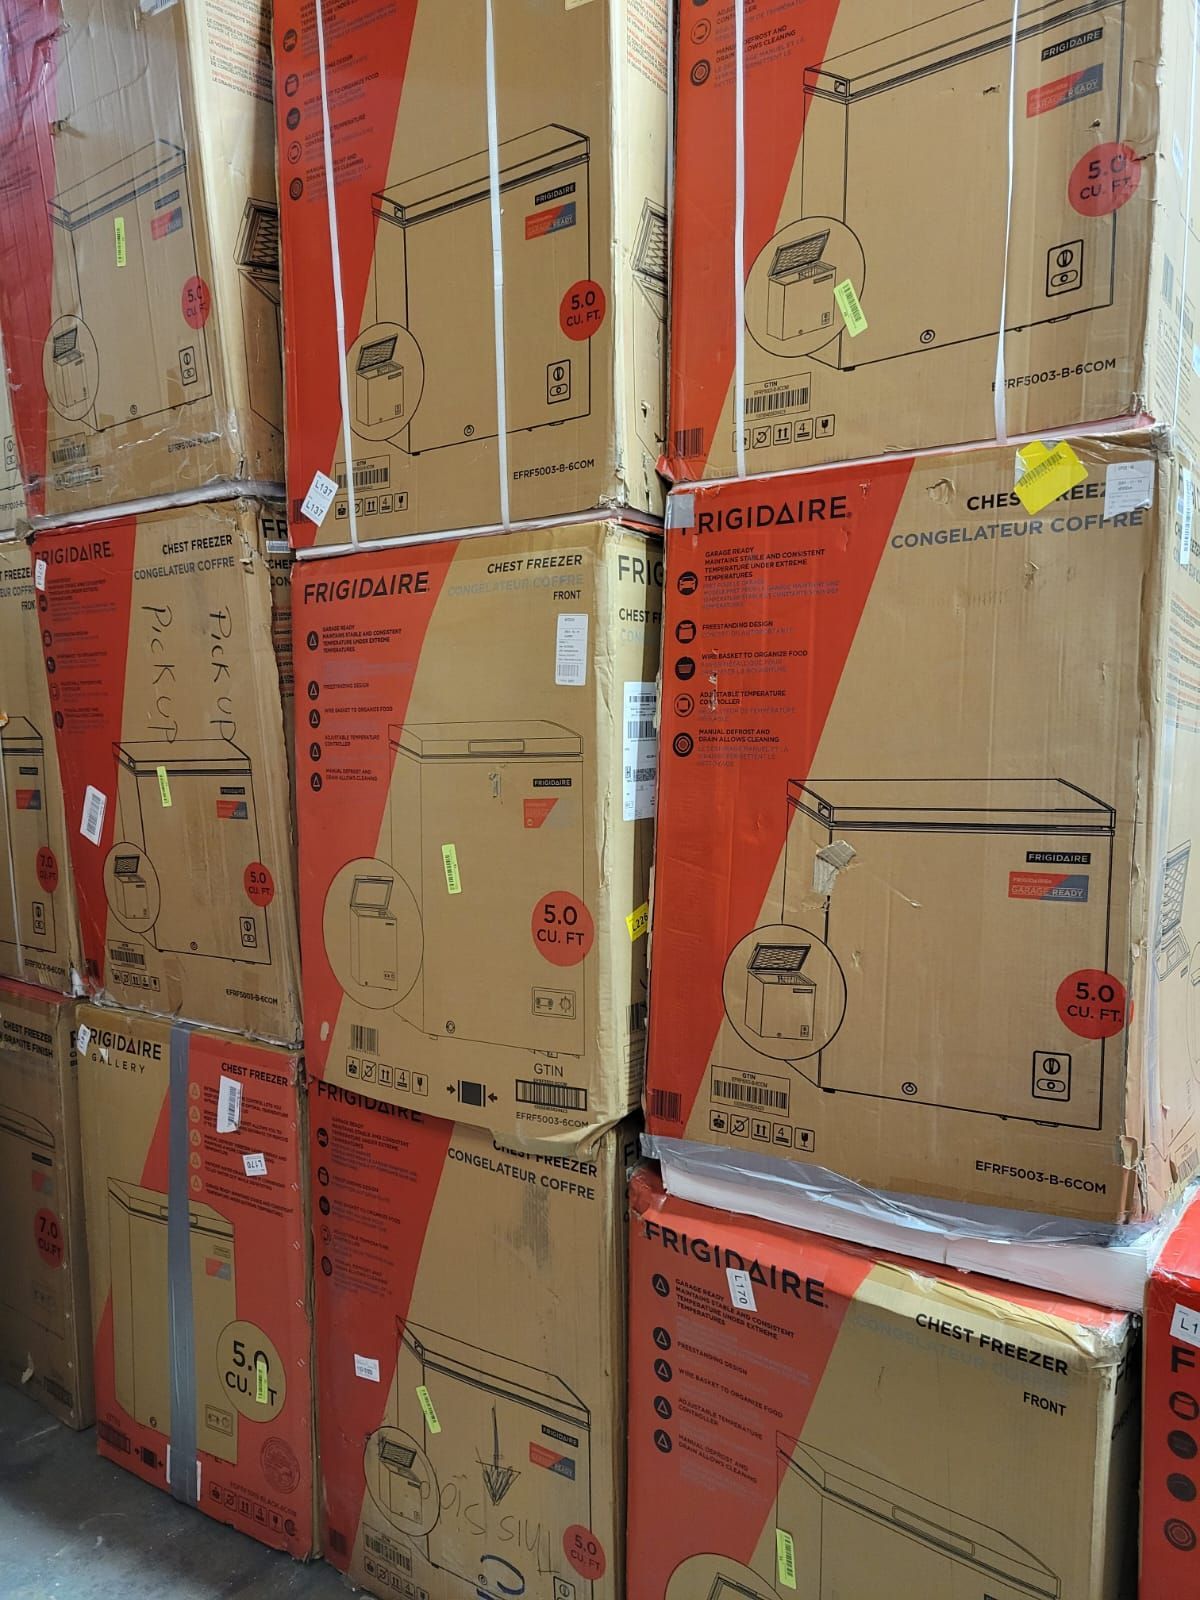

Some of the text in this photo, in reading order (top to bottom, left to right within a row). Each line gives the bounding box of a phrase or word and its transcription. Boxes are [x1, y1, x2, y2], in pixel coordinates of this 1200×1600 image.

[763, 29, 797, 46] CLEANING
[773, 25, 787, 35] AND
[1042, 31, 1102, 60] FRIGIDAIRE
[1068, 79, 1098, 98] READY
[1088, 155, 1128, 180] 5.0
[535, 184, 575, 204] FRIGIDAIRE
[571, 291, 596, 310] 5.0
[566, 309, 601, 327] CU. FT.
[992, 358, 1117, 392] RF5003-B-6COM
[513, 459, 595, 480] EFRF5003-B-6COM
[313, 479, 334, 497] L137
[305, 500, 325, 517] L137
[966, 492, 1022, 512] CHES
[162, 534, 233, 555] CHEST FREEZER
[891, 520, 1043, 549] CONGELATEUR
[704, 546, 754, 558] GARAGE READY
[704, 548, 826, 566] MAINTAINS STABLE AND CONSISTENT
[134, 556, 235, 580] CONGELATEUR COFFRE
[487, 554, 583, 574] CHEST FREEZER
[704, 559, 808, 574] TEMPERATURE UNDER EXTREME
[704, 571, 753, 582] TEMPERATURES
[304, 571, 430, 605] FRIGIDAIRE
[553, 589, 582, 601] FRONT
[618, 607, 650, 623] CHEST
[702, 620, 774, 631] FREESTANDING DESIGN
[718, 652, 743, 660] BASKET
[741, 690, 786, 698] TEMPERATURE
[698, 736, 719, 744] DRAIN
[746, 736, 780, 744] CLEANING
[726, 728, 755, 736] DEFROST
[534, 778, 571, 787] FRIGIDAIRE
[1028, 853, 1089, 864] FRIGIDAIRE
[250, 871, 267, 884] 5.0
[1011, 886, 1084, 898] GARAGE READY
[543, 904, 578, 926] 5.0
[537, 929, 585, 946] CU. FT
[1075, 982, 1115, 1003] 5.0
[1066, 1004, 1123, 1024] CU. FT.
[3, 1020, 53, 1044] CHEST FREEZER
[87, 1026, 162, 1061] RIGIDAIRE
[92, 1053, 146, 1074] GALLERY
[533, 1062, 564, 1077] GTIN
[221, 1062, 289, 1087] CHEST FREEZER
[742, 1072, 756, 1081] GTIN
[516, 1111, 589, 1129] EFRF5003-6COM
[447, 1147, 596, 1200] CONGELATEUR COFFRE
[975, 1159, 1107, 1195] EFRF5003-B-6COM
[39, 1216, 59, 1240] 7.0
[643, 1219, 826, 1308] FRIGIDAIRE
[675, 1278, 725, 1302] GARAGE READY
[734, 1273, 749, 1306] L170
[675, 1286, 795, 1338] MAINTAINS STABLE AND CONSISTENT
[677, 1301, 726, 1327] TEMPERATURES
[677, 1294, 778, 1340] TEMPERATURE UNDER EXTREME
[915, 1312, 1069, 1376] CHEST FREEZER
[677, 1341, 748, 1376] FREESTANDING DESIGN
[225, 1370, 252, 1396] CU.
[678, 1367, 784, 1419] WIRE BASKET TO ORGANIZE FOOD
[1022, 1391, 1067, 1417] FRONT
[678, 1405, 719, 1427] CONTROLLER
[679, 1398, 763, 1441] ADJUSTABLE TEMPERATURE
[542, 1426, 578, 1447] FRIGIDAIRE
[678, 1433, 749, 1472] MANUAL DEFROST AND
[699, 1450, 725, 1467] ALLOWS
[725, 1463, 758, 1484] CLEANING
[574, 1534, 598, 1556] 5.0
